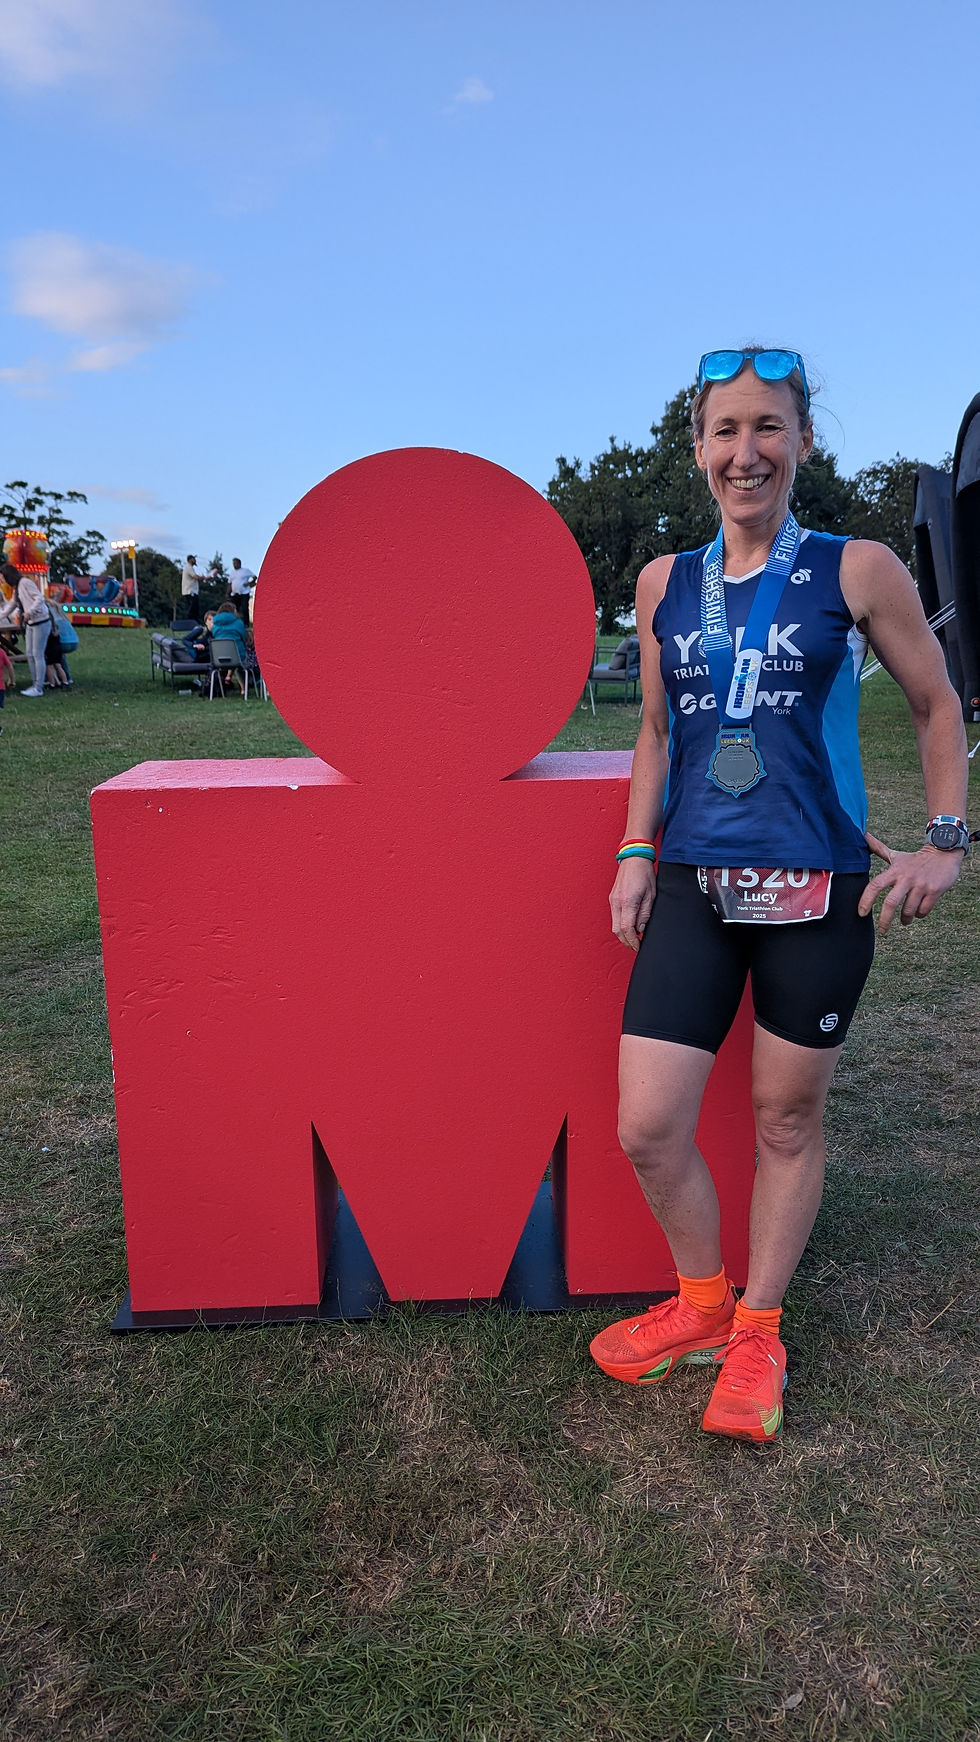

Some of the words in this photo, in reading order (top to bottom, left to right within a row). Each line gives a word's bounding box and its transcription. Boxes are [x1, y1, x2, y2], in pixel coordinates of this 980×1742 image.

[705, 559, 724, 635] FINISHER
[673, 623, 804, 664] YK
[762, 660, 804, 672] CLUB
[699, 691, 803, 710] GNT
[772, 707, 791, 716] York
[720, 867, 810, 888] 1320
[743, 891, 778, 905] Lucy
